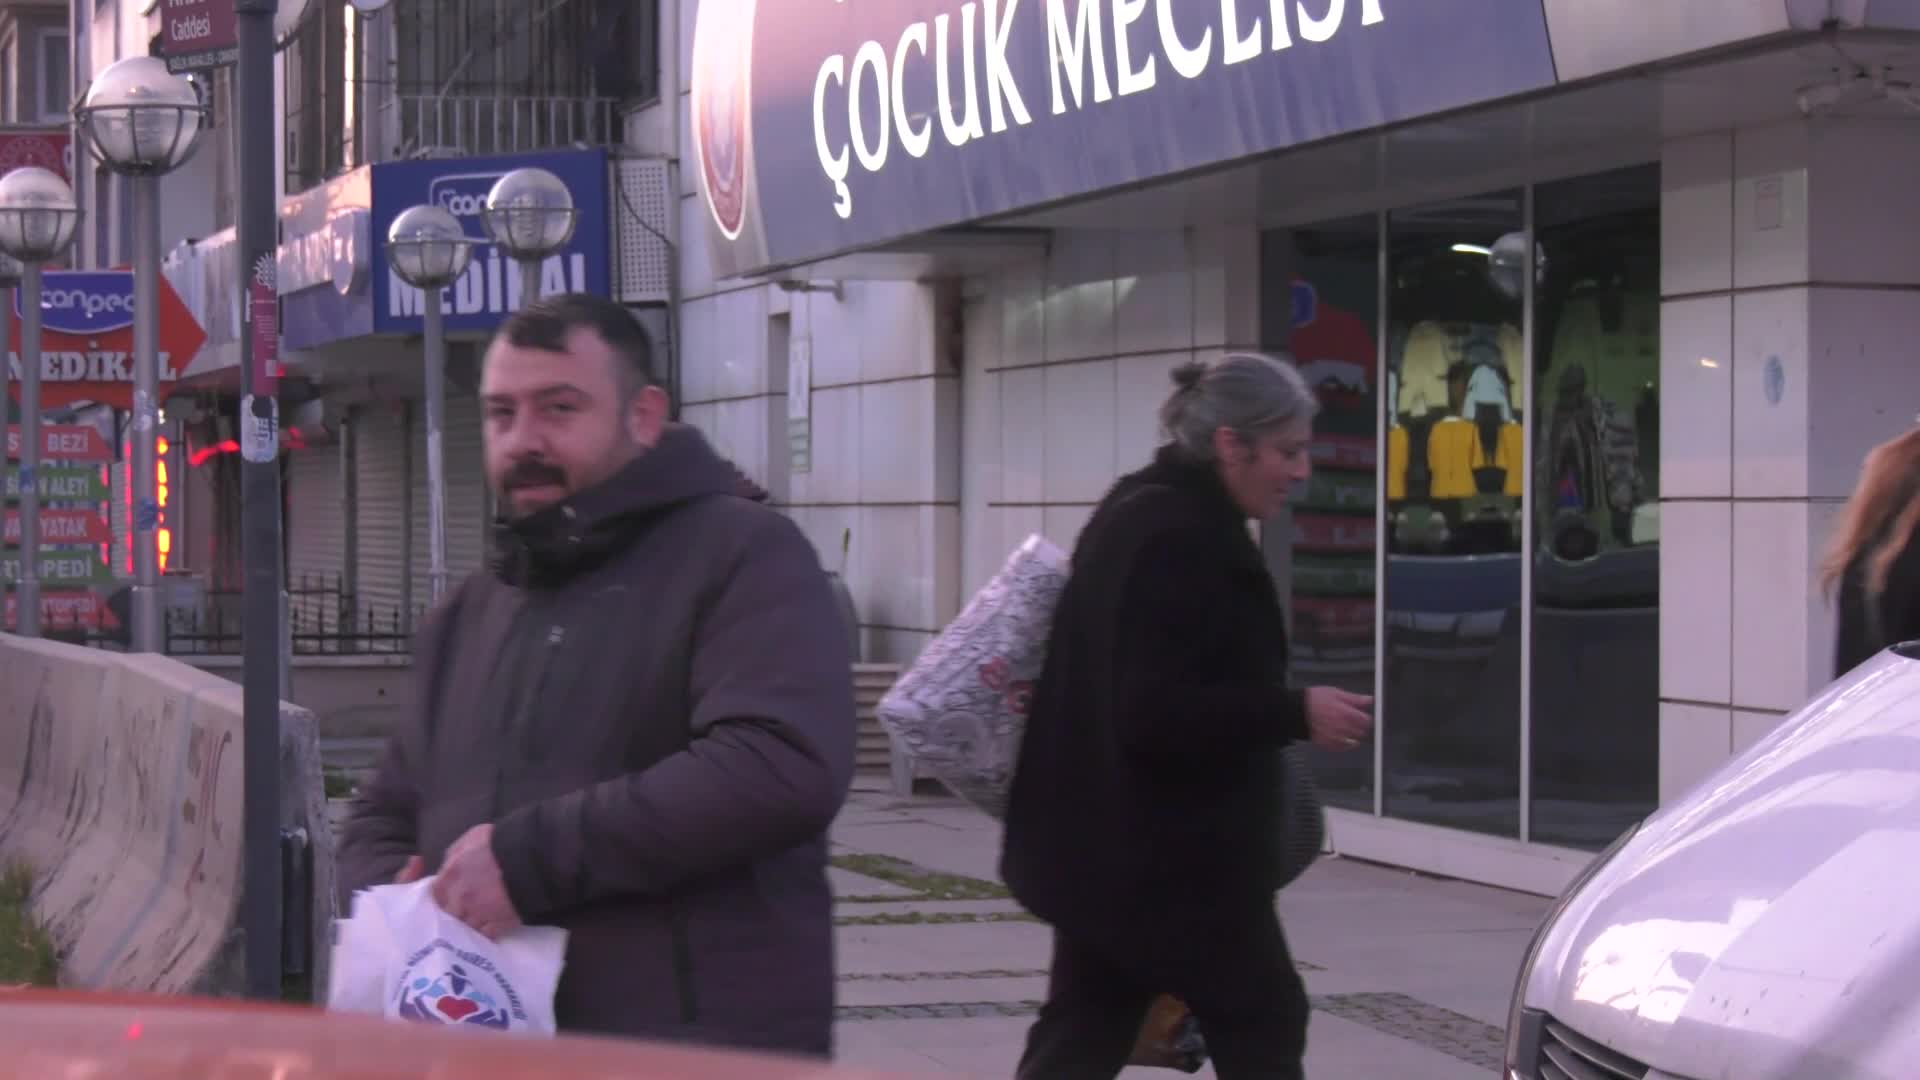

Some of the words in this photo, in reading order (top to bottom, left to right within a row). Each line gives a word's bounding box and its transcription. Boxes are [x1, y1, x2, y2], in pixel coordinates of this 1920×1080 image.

[171, 12, 211, 41] Caddesi
[813, 0, 1032, 218] ÇOCUK
[1046, 0, 1384, 115] MECL
[8, 340, 176, 381] EDİKL
[47, 430, 88, 452] BEZİ
[40, 517, 87, 537] YATAK
